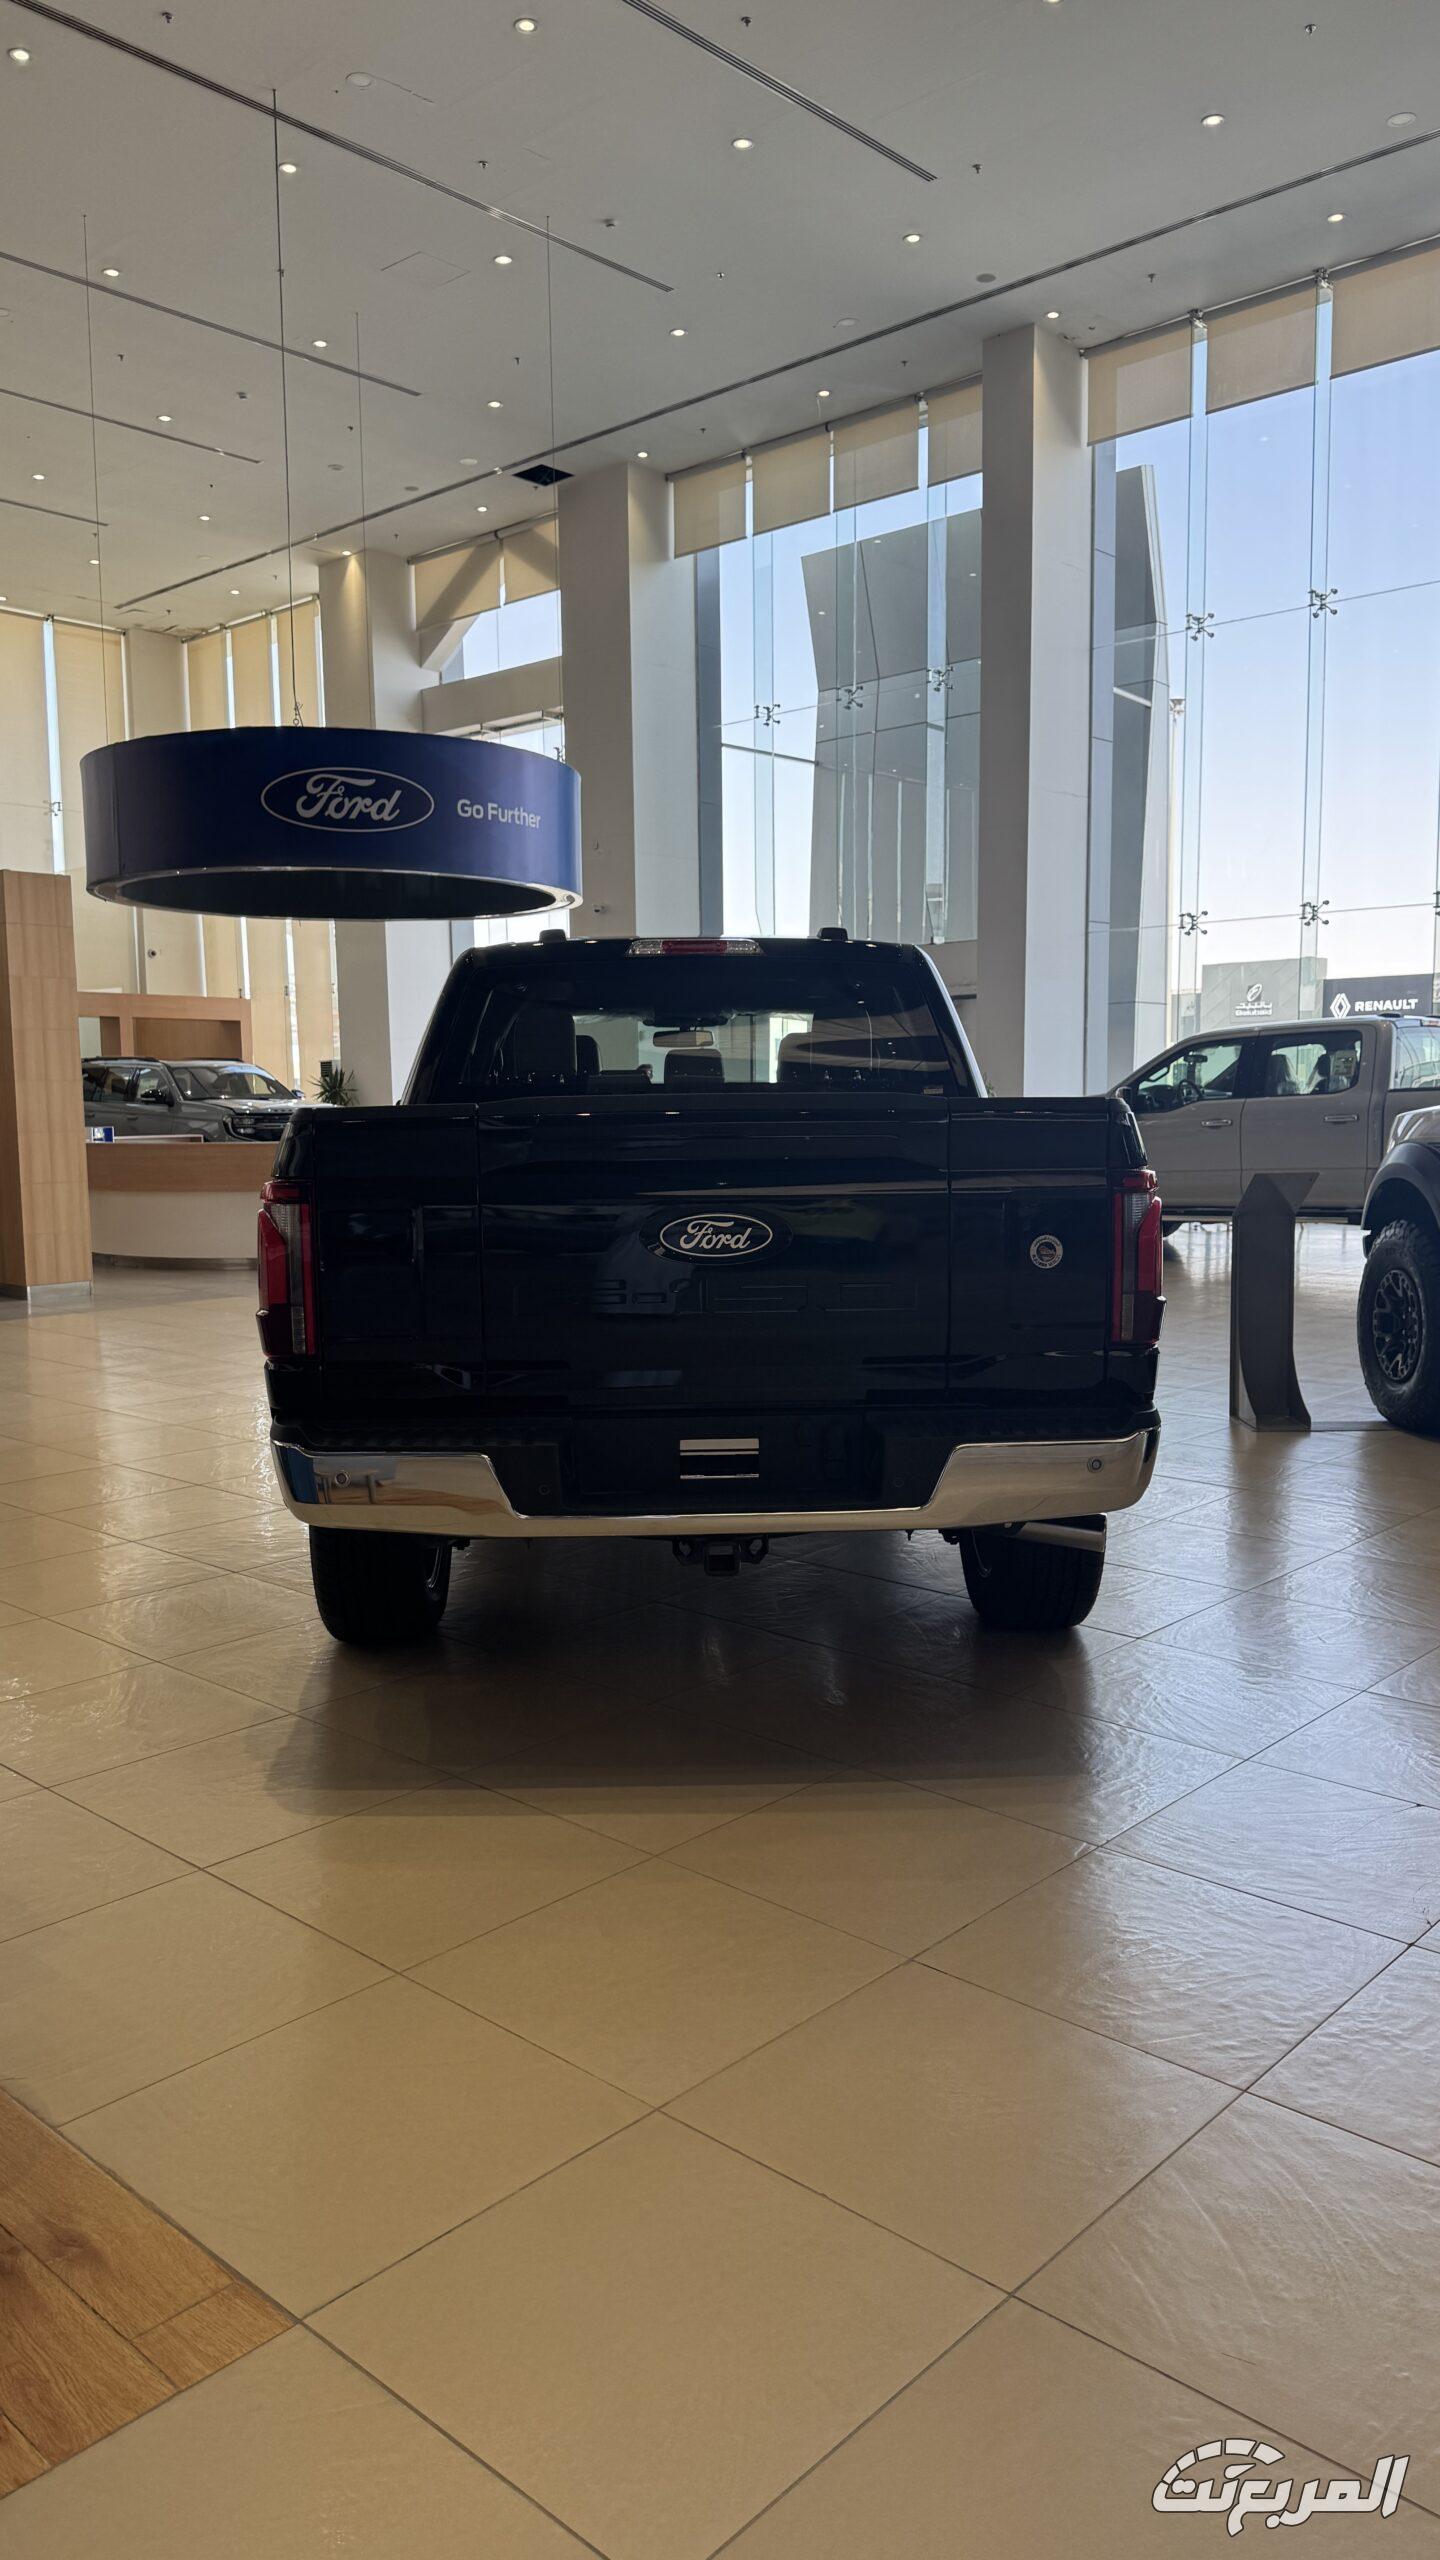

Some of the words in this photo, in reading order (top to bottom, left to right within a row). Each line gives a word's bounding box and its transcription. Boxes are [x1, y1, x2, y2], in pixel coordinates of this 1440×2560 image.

[295, 773, 402, 822] Ford
[457, 799, 484, 819] Go
[487, 802, 541, 829] Further
[1354, 998, 1419, 1012] RENAULT
[680, 1220, 752, 1249] Ford
